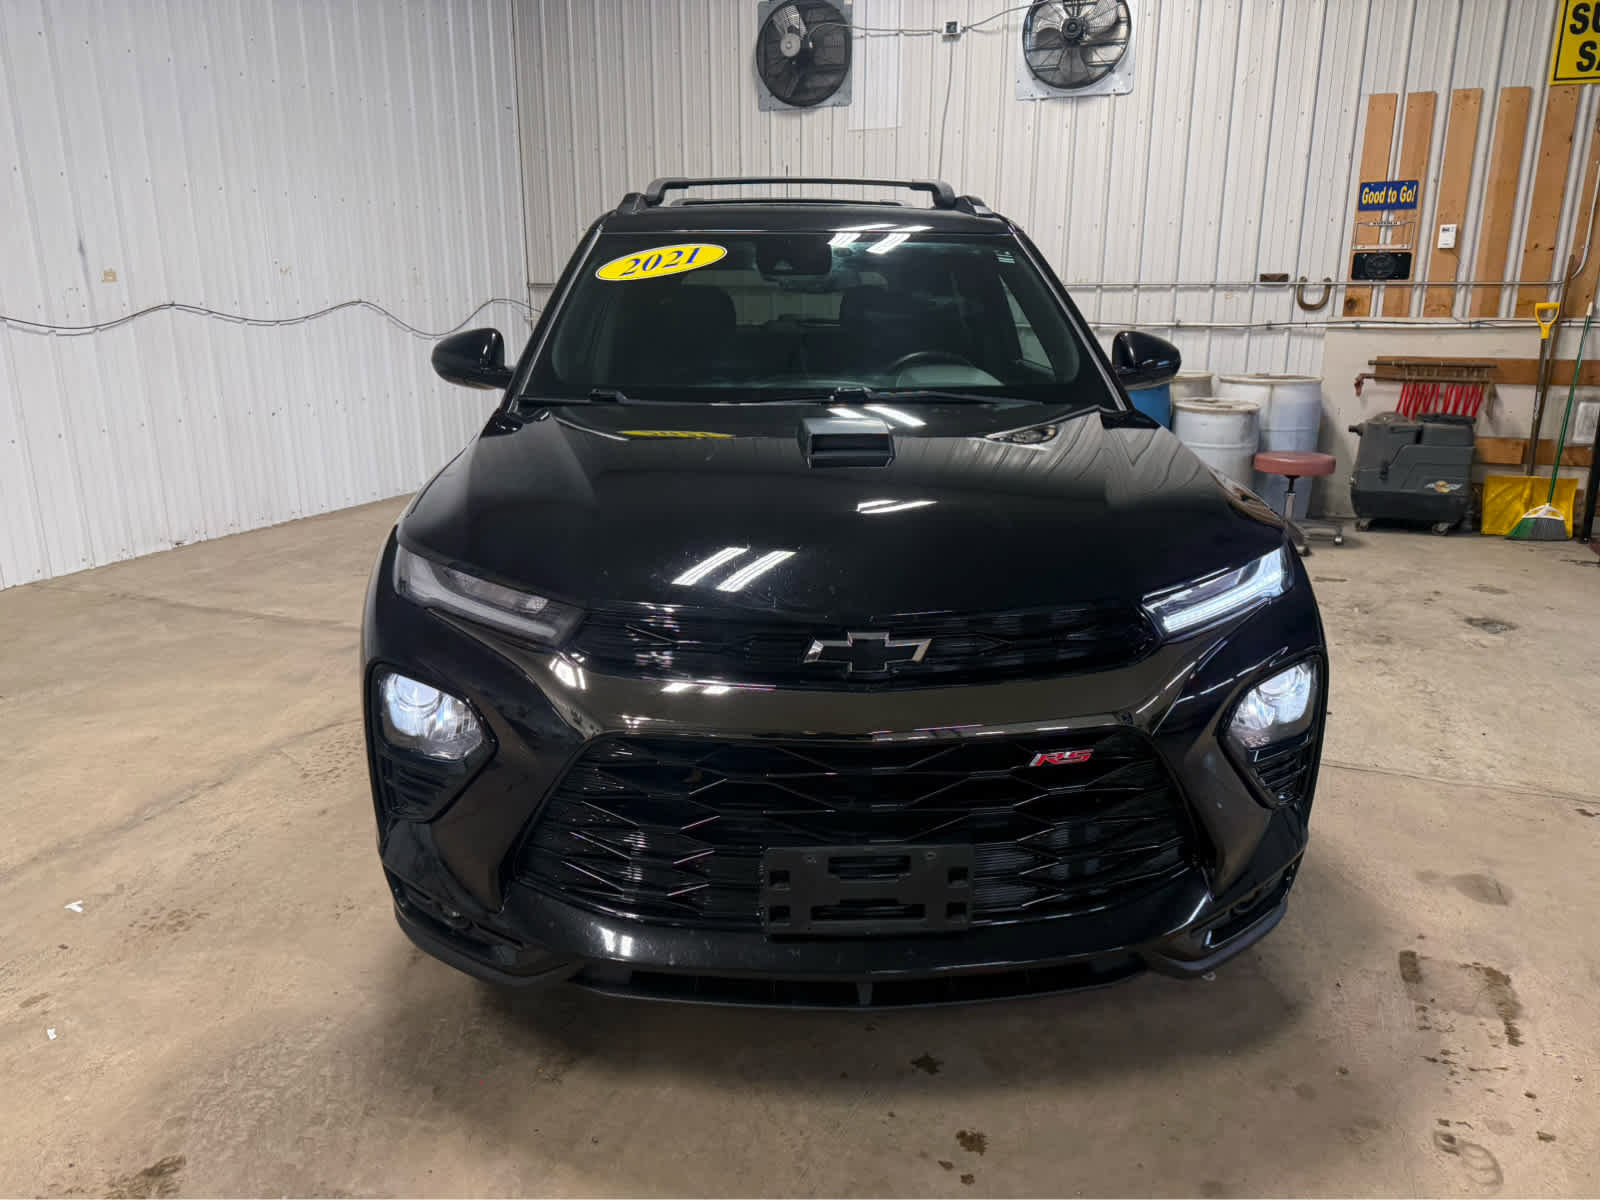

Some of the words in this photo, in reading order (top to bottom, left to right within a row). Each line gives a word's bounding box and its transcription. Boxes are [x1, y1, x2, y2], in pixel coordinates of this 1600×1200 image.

[1576, 40, 1600, 73] S
[1362, 186, 1387, 205] Good
[1387, 187, 1398, 204] to
[1399, 184, 1417, 204] Go!
[619, 247, 701, 277] 2021
[1028, 748, 1095, 768] RS
